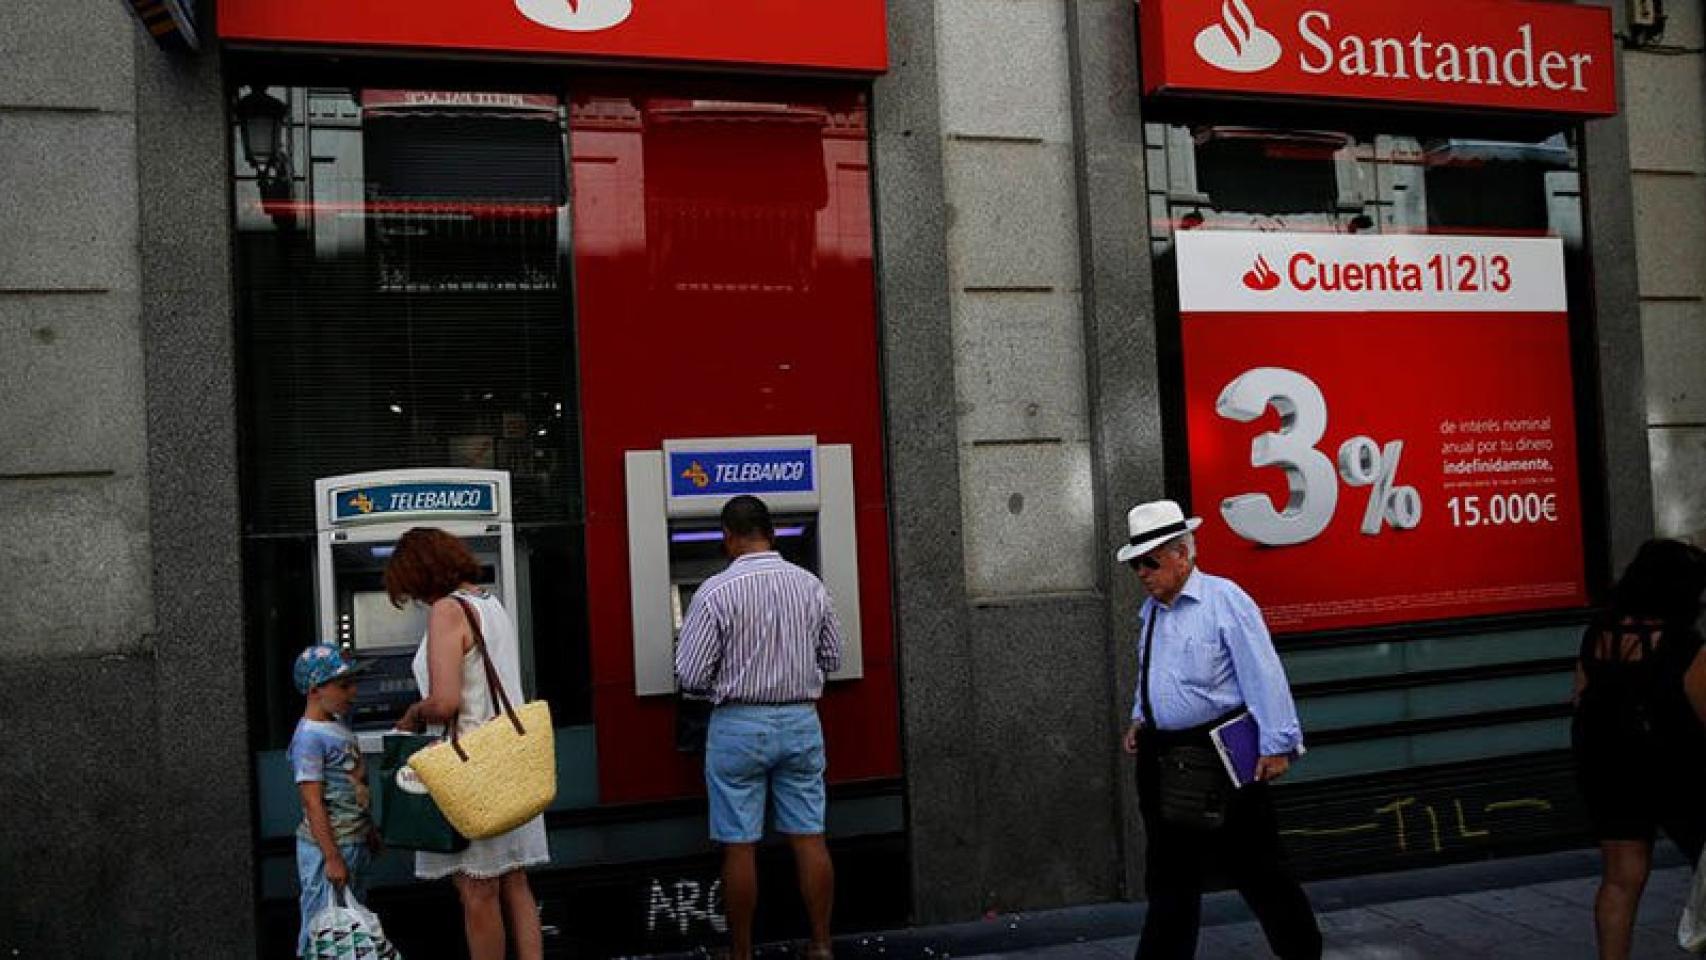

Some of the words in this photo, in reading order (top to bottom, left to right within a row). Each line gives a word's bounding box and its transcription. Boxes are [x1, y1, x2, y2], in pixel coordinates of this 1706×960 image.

[1299, 10, 1592, 92] Santander
[1288, 252, 1422, 292] Cuenta
[1440, 419, 1457, 433] de
[1503, 416, 1551, 431] nominal
[1216, 366, 1423, 546] 3%
[1442, 440, 1474, 453] anual
[1477, 442, 1497, 454] por
[1501, 439, 1513, 452] tu
[1516, 438, 1552, 450] dinero
[715, 460, 805, 483] TELEBANCO
[389, 489, 481, 510] TELEBANCO
[1447, 492, 1558, 527] 15.000€
